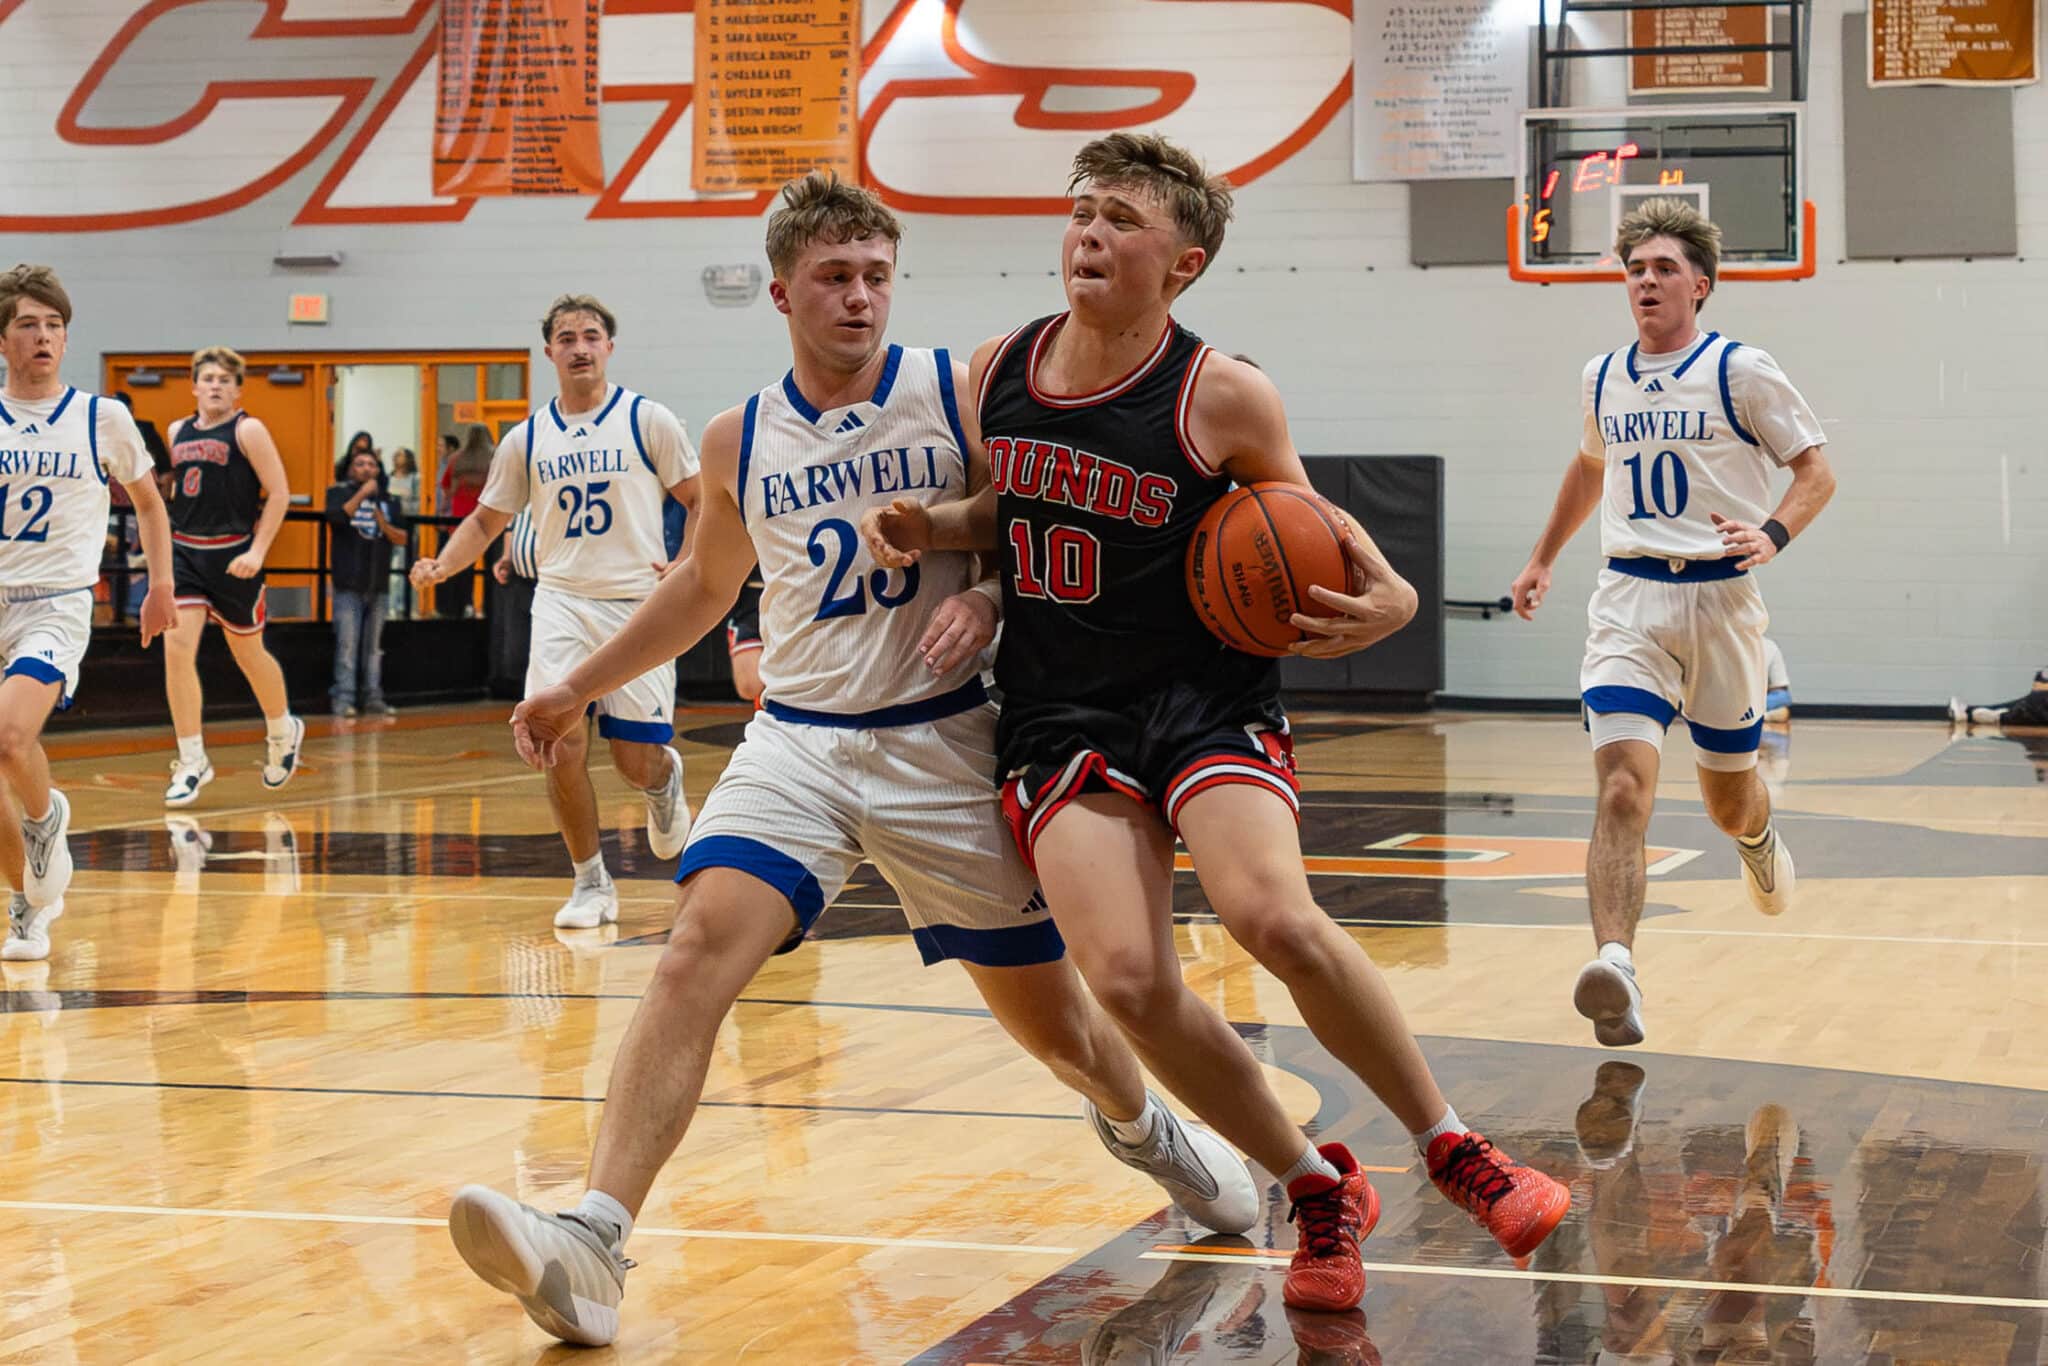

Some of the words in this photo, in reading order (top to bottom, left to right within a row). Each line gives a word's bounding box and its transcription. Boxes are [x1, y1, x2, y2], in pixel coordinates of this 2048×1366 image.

[1604, 410, 1714, 445] FARWELL
[183, 466, 202, 497] 0
[537, 449, 629, 485] FARWELL
[761, 446, 948, 519] FARWELL
[983, 436, 1178, 528] OUNDS
[1624, 450, 1689, 520] 10
[558, 480, 613, 539] 25
[1009, 518, 1101, 604] 10
